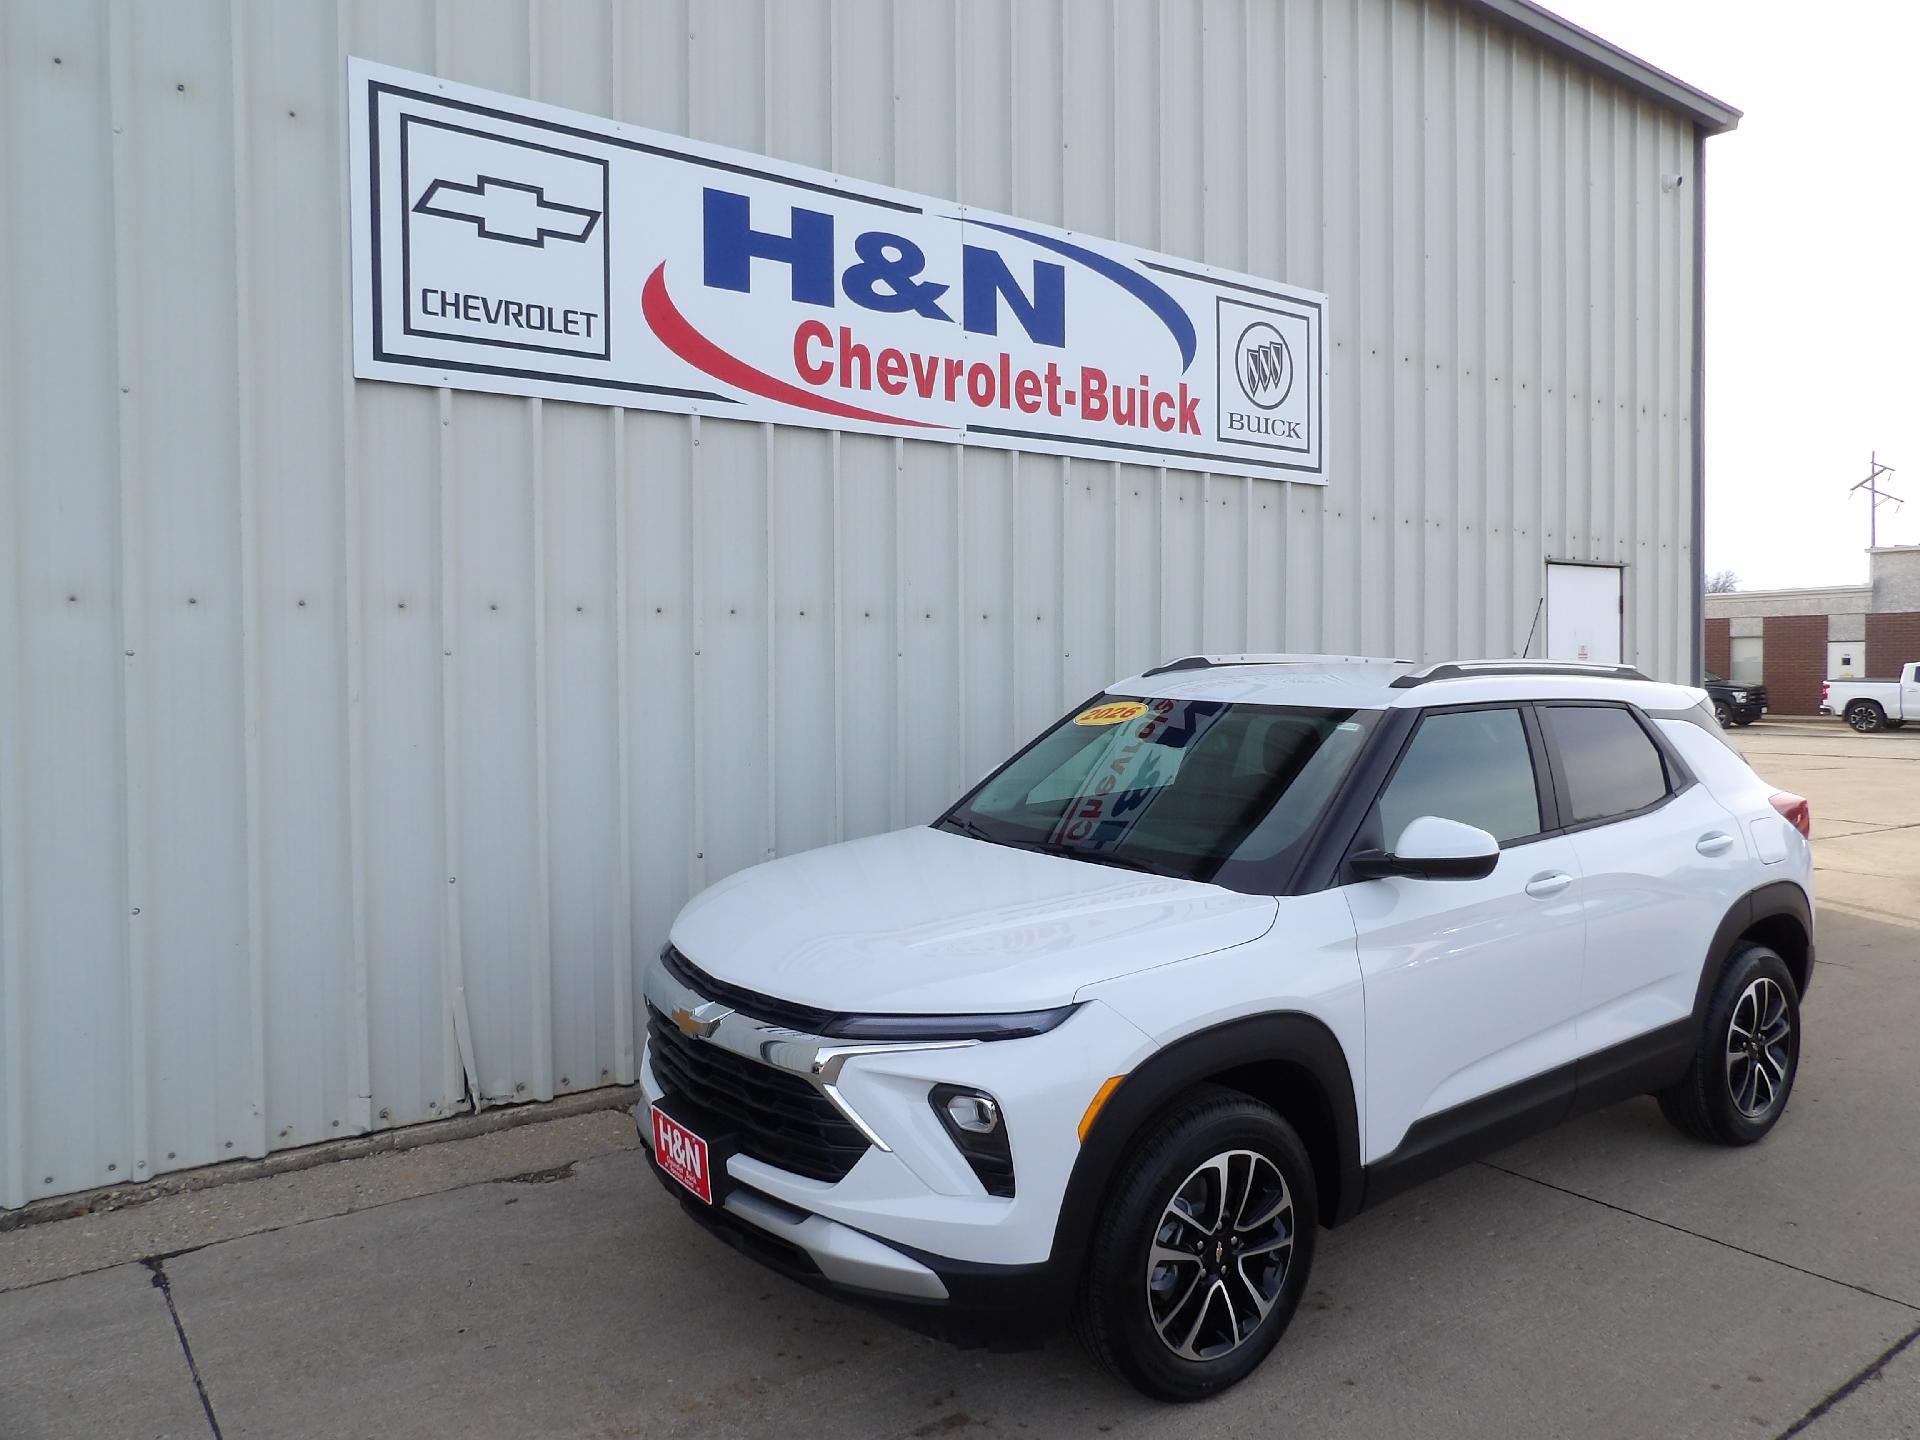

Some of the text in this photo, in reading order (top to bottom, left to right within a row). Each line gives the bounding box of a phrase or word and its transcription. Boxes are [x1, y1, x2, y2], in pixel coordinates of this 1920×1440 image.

[703, 187, 1066, 349] H&N
[421, 288, 599, 338] CHEVROLET
[793, 319, 1202, 436] Chevrolet-Buick
[1226, 411, 1303, 440] BUICK
[1079, 706, 1143, 721] 2026
[658, 1117, 702, 1179] H&N
